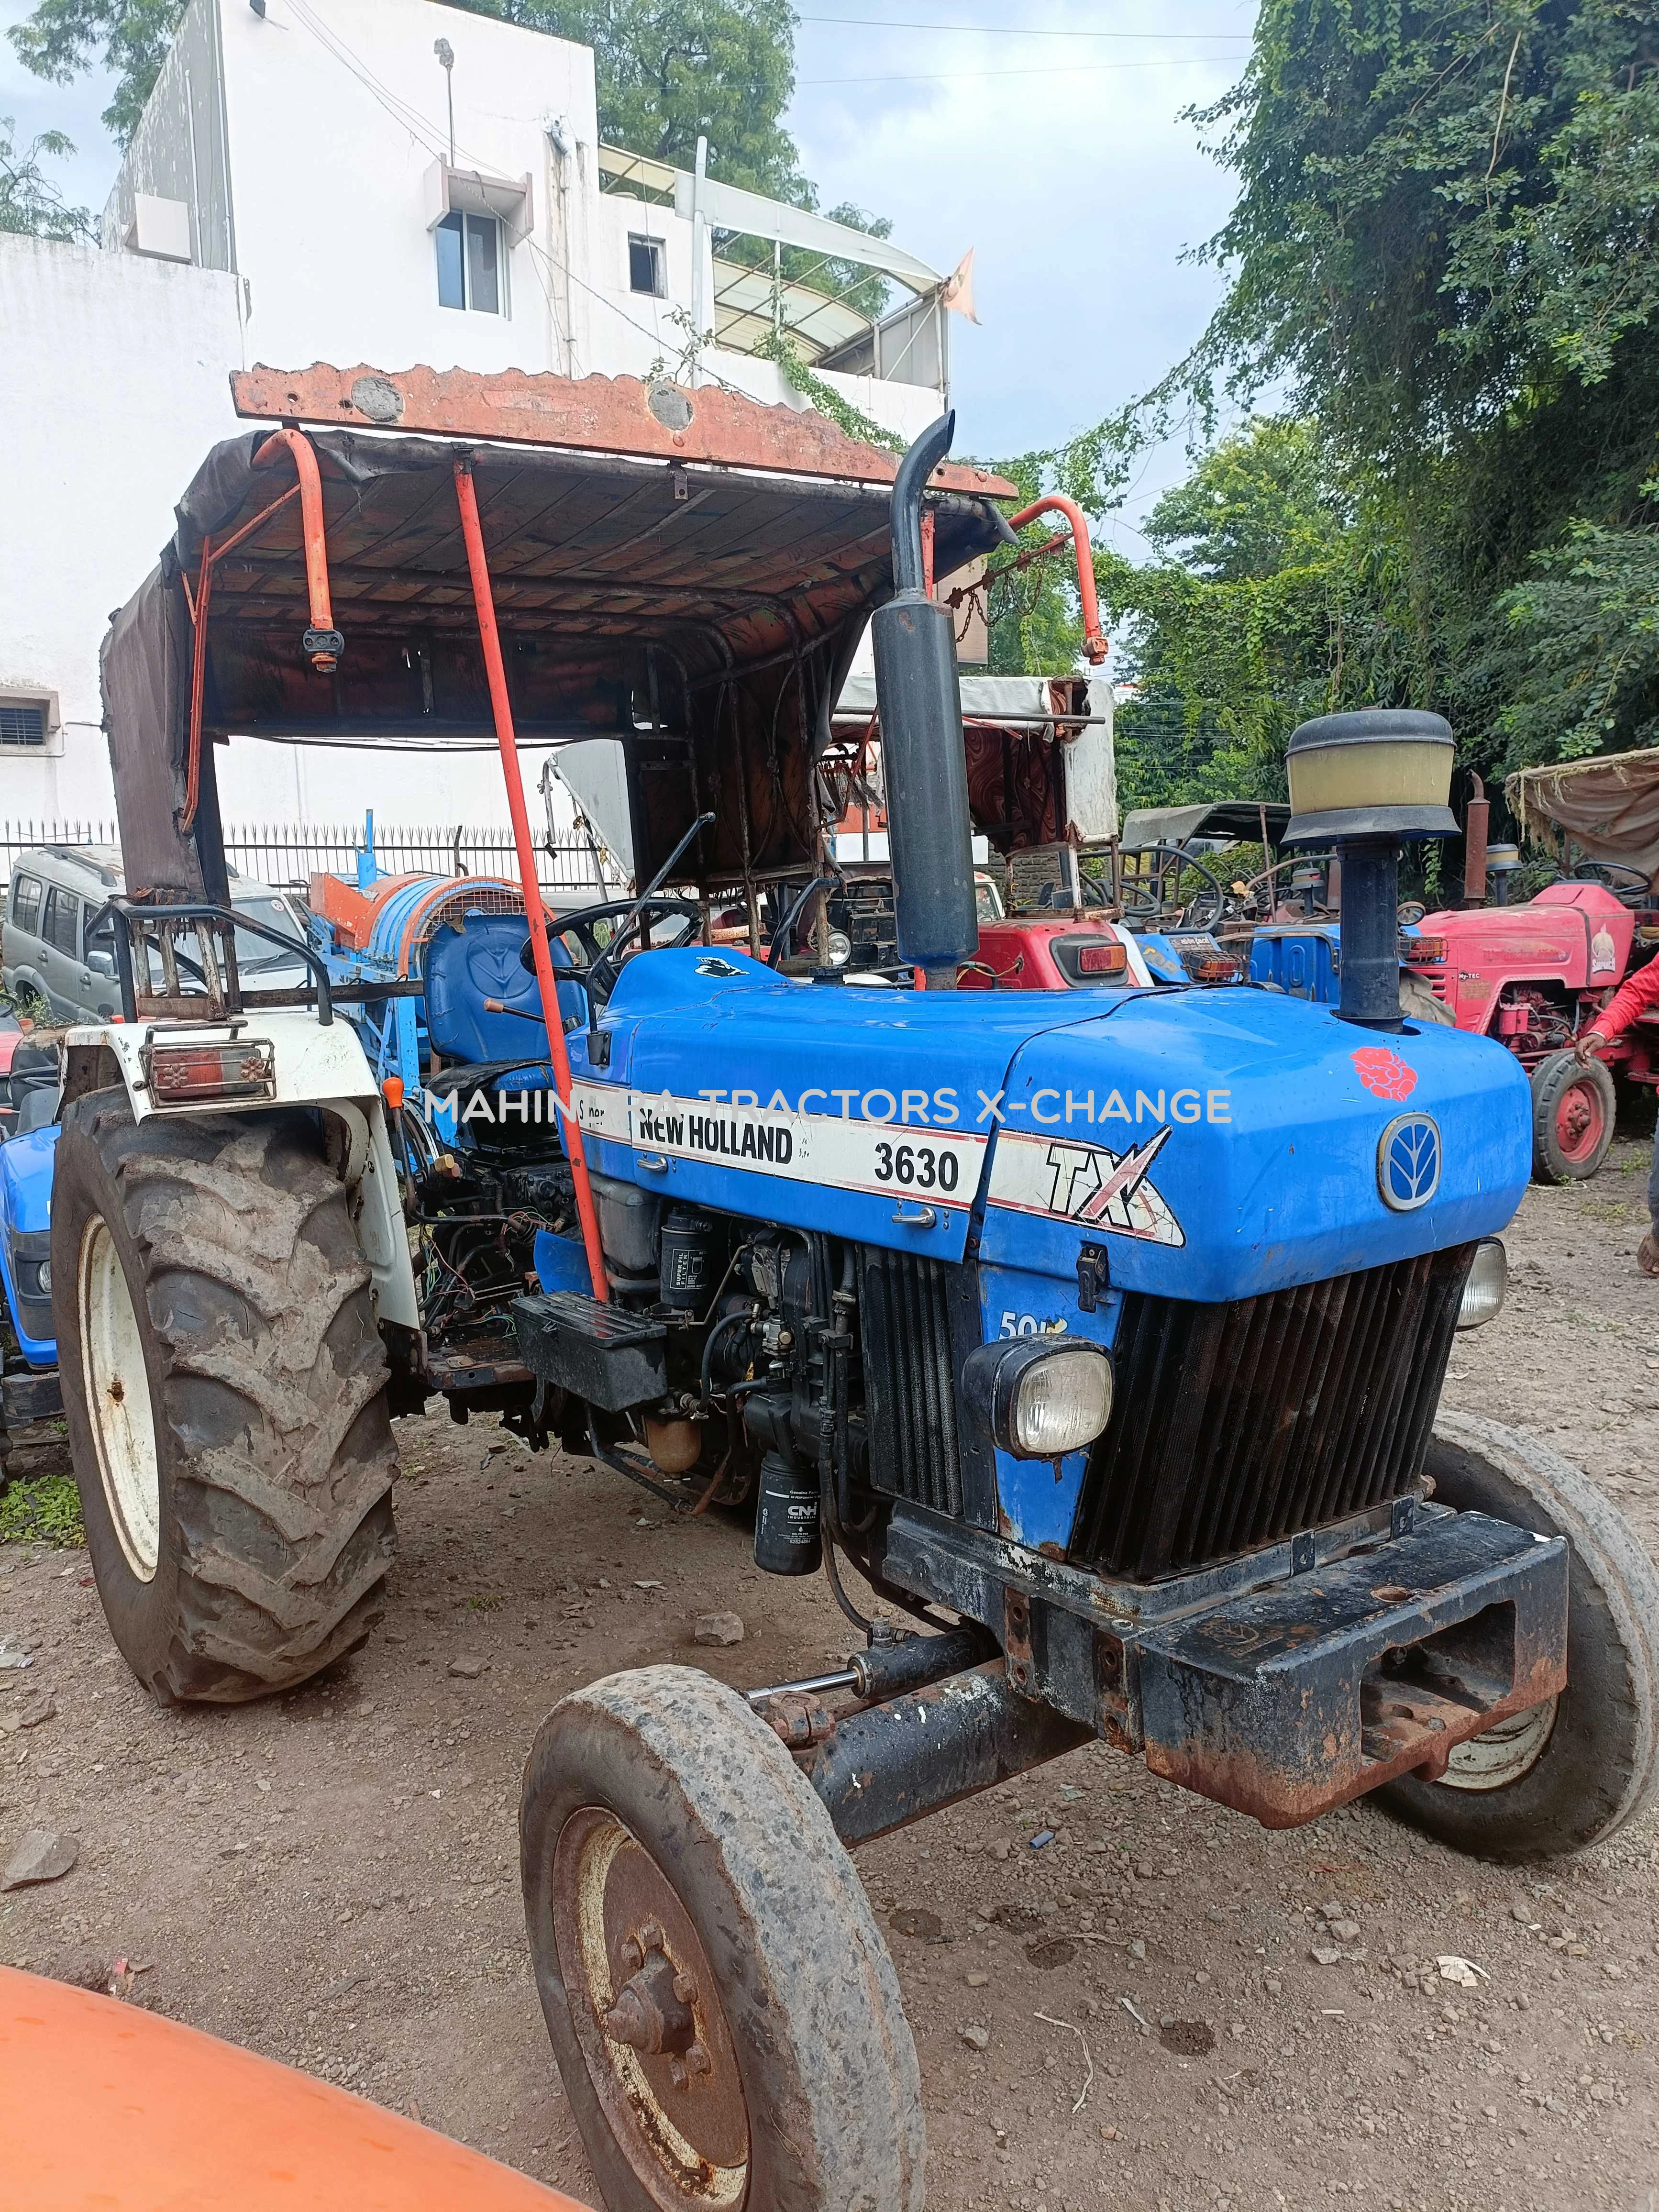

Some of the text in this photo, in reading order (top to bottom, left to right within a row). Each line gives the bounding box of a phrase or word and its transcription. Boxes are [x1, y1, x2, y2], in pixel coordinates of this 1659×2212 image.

[579, 1099, 604, 1128] Sper
[640, 1108, 793, 1164] NEW HOLLAND
[874, 1142, 958, 1192] 3630
